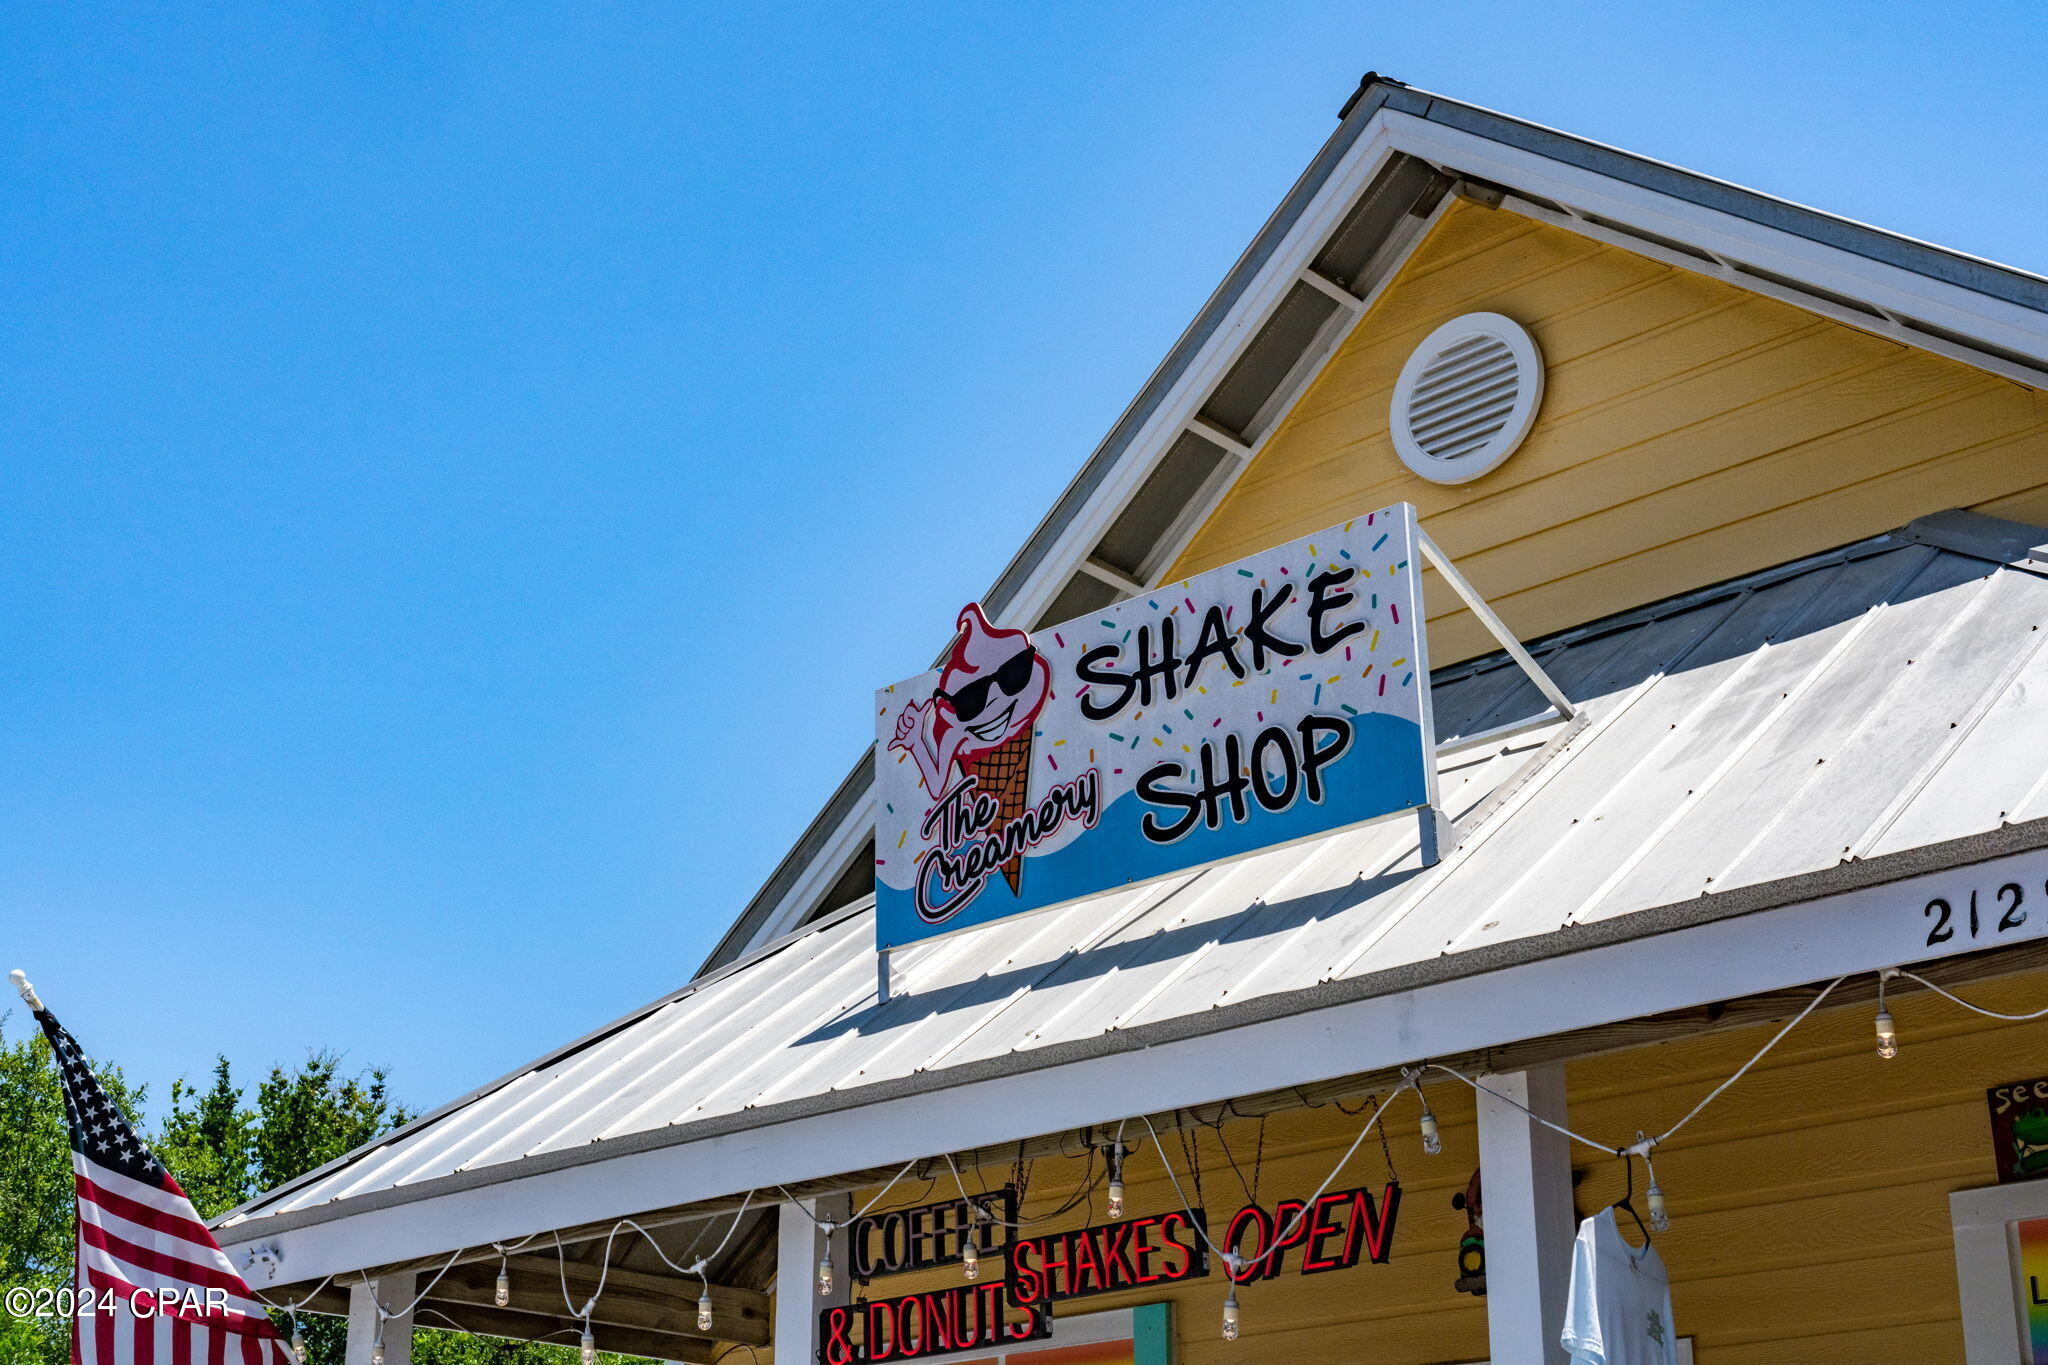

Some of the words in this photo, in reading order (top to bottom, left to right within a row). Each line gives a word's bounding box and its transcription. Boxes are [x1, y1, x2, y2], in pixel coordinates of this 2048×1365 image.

[1075, 567, 1368, 722] SHAKE
[921, 774, 999, 852] The
[1135, 714, 1354, 844] SHOP
[915, 768, 1101, 924] Creamery
[1924, 879, 2048, 948] 212
[856, 1193, 1000, 1277] COFFEE
[1013, 1213, 1190, 1303] SHAKES
[1222, 1185, 1395, 1283] OPEN
[827, 1308, 853, 1365] &
[869, 1277, 1034, 1361] DONUTS
